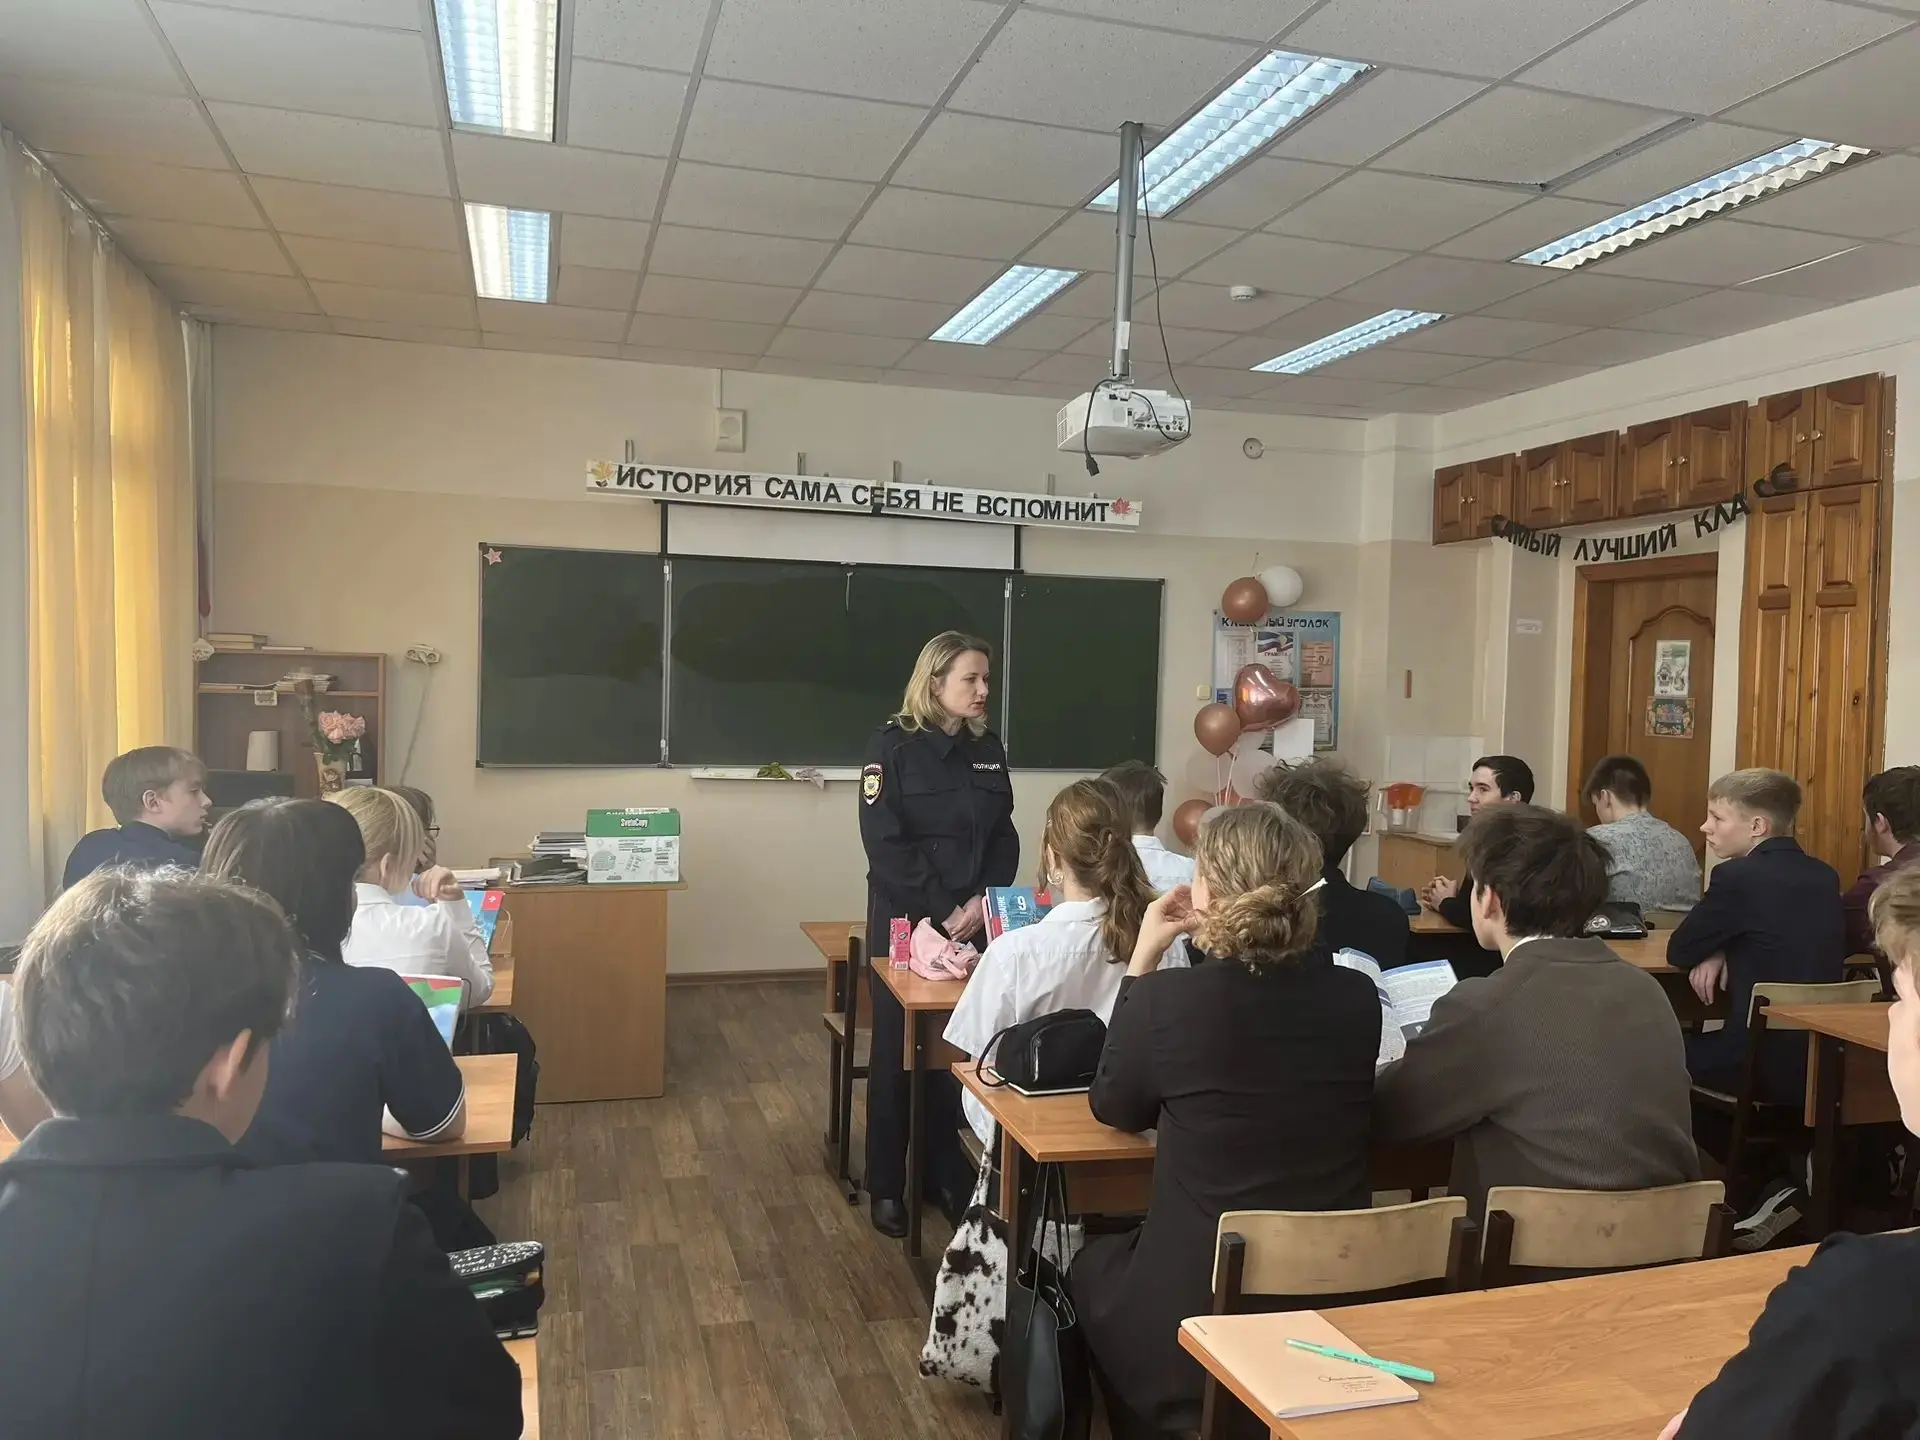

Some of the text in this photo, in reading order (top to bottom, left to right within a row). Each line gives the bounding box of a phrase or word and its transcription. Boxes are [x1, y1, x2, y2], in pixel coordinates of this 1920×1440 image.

[616, 465, 1110, 522] ИСТОРИЯ САМА СЕБЯ НЕ ВСПОМНИТ
[1491, 463, 1798, 561] САМЫЙ ЛУЧШИЙ КЛАСС
[1287, 618, 1329, 628] УГОЛОК
[972, 763, 1001, 771] ПОЛИЦИЯ
[1017, 895, 1027, 911] 9
